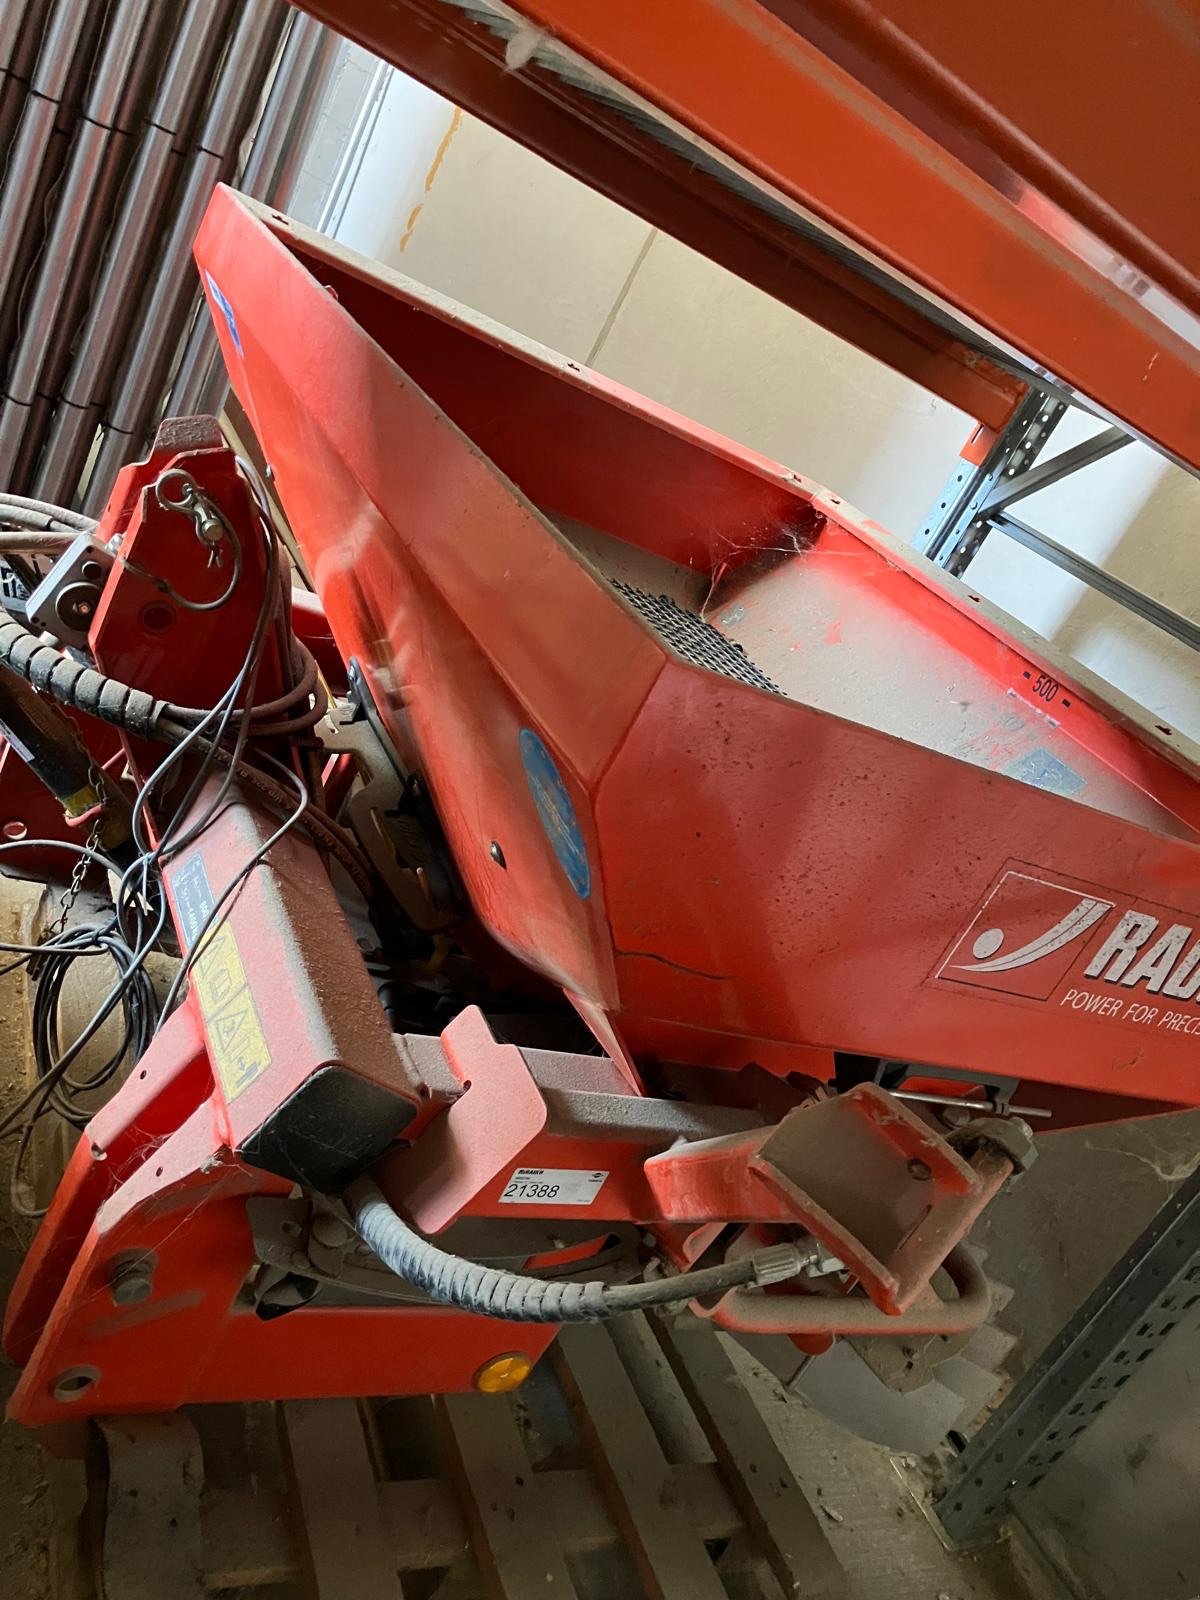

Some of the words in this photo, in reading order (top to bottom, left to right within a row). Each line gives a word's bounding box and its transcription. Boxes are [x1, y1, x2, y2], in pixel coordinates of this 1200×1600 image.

[1032, 674, 1059, 702] 500
[1083, 909, 1200, 1002] RAU
[1060, 988, 1123, 1017] POWER
[1122, 1002, 1159, 1025] FOR
[503, 1183, 560, 1198] 21388
